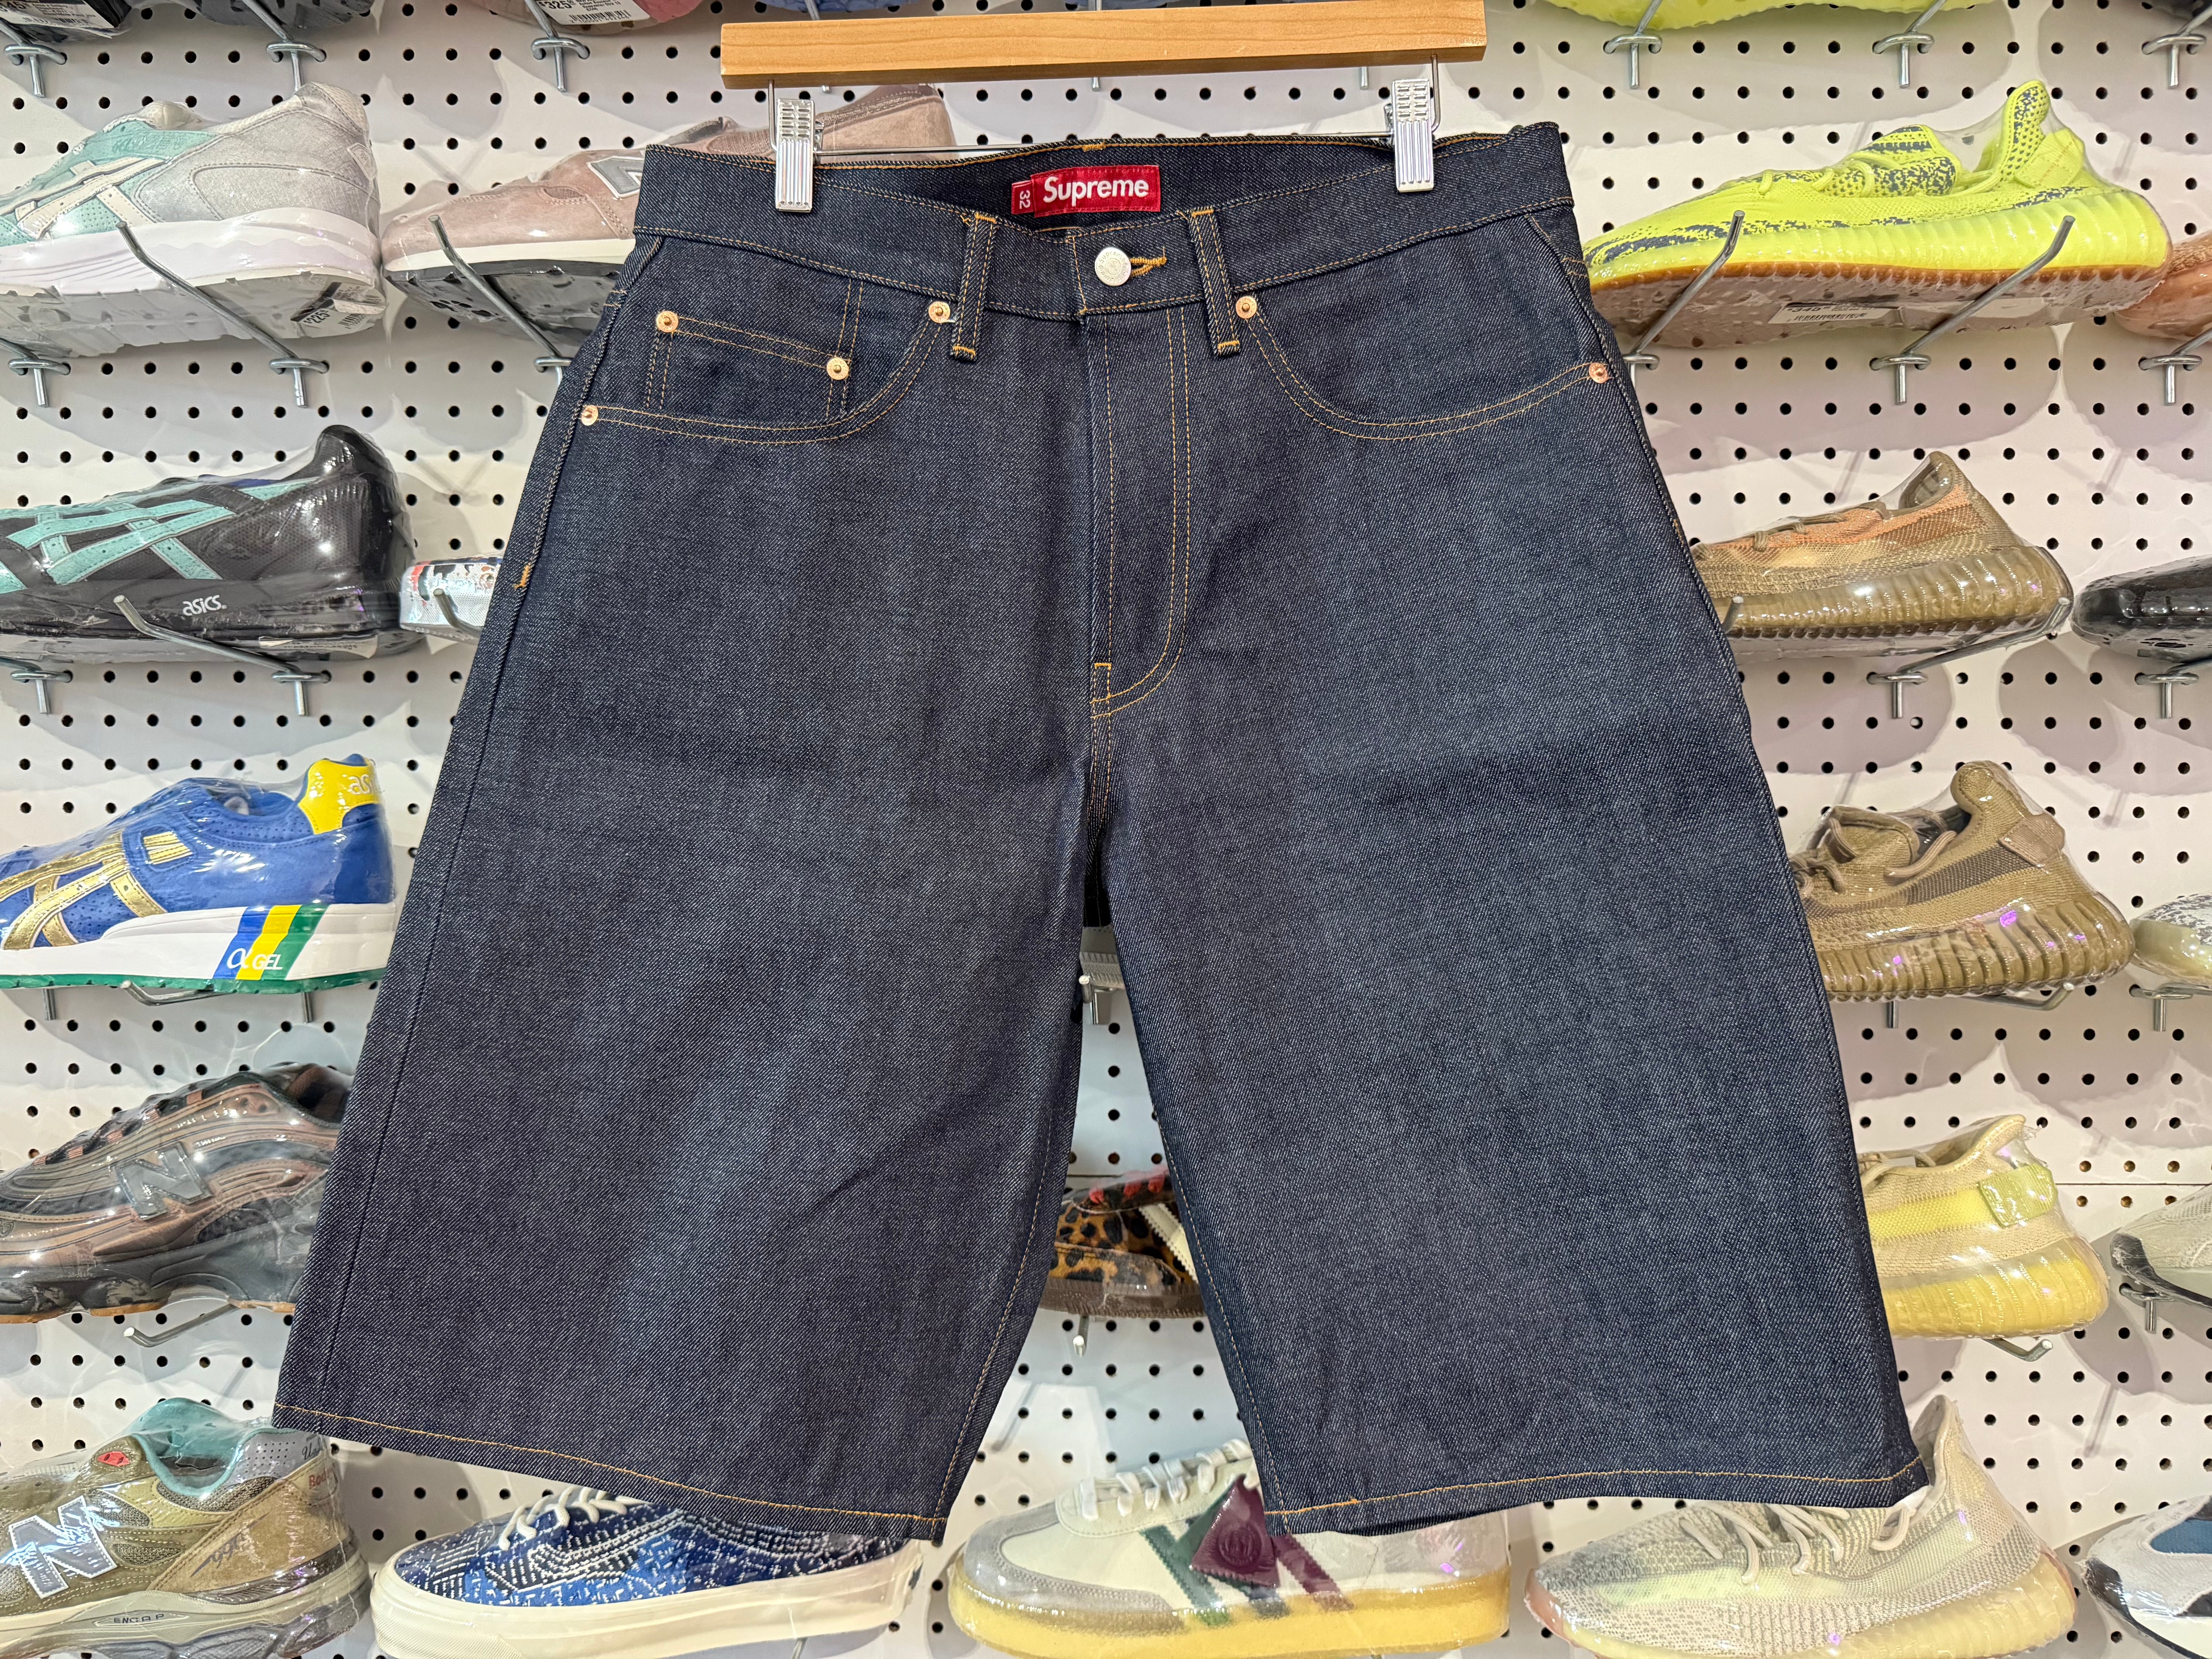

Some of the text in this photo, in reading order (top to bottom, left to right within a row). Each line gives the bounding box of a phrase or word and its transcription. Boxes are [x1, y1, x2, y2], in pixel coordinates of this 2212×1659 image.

[1019, 190, 1031, 209] 32
[1043, 176, 1149, 207] Supreme
[304, 312, 330, 324] $225
[183, 594, 222, 616] asics
[252, 954, 283, 970] GEL
[114, 1614, 164, 1623] ENCAP
